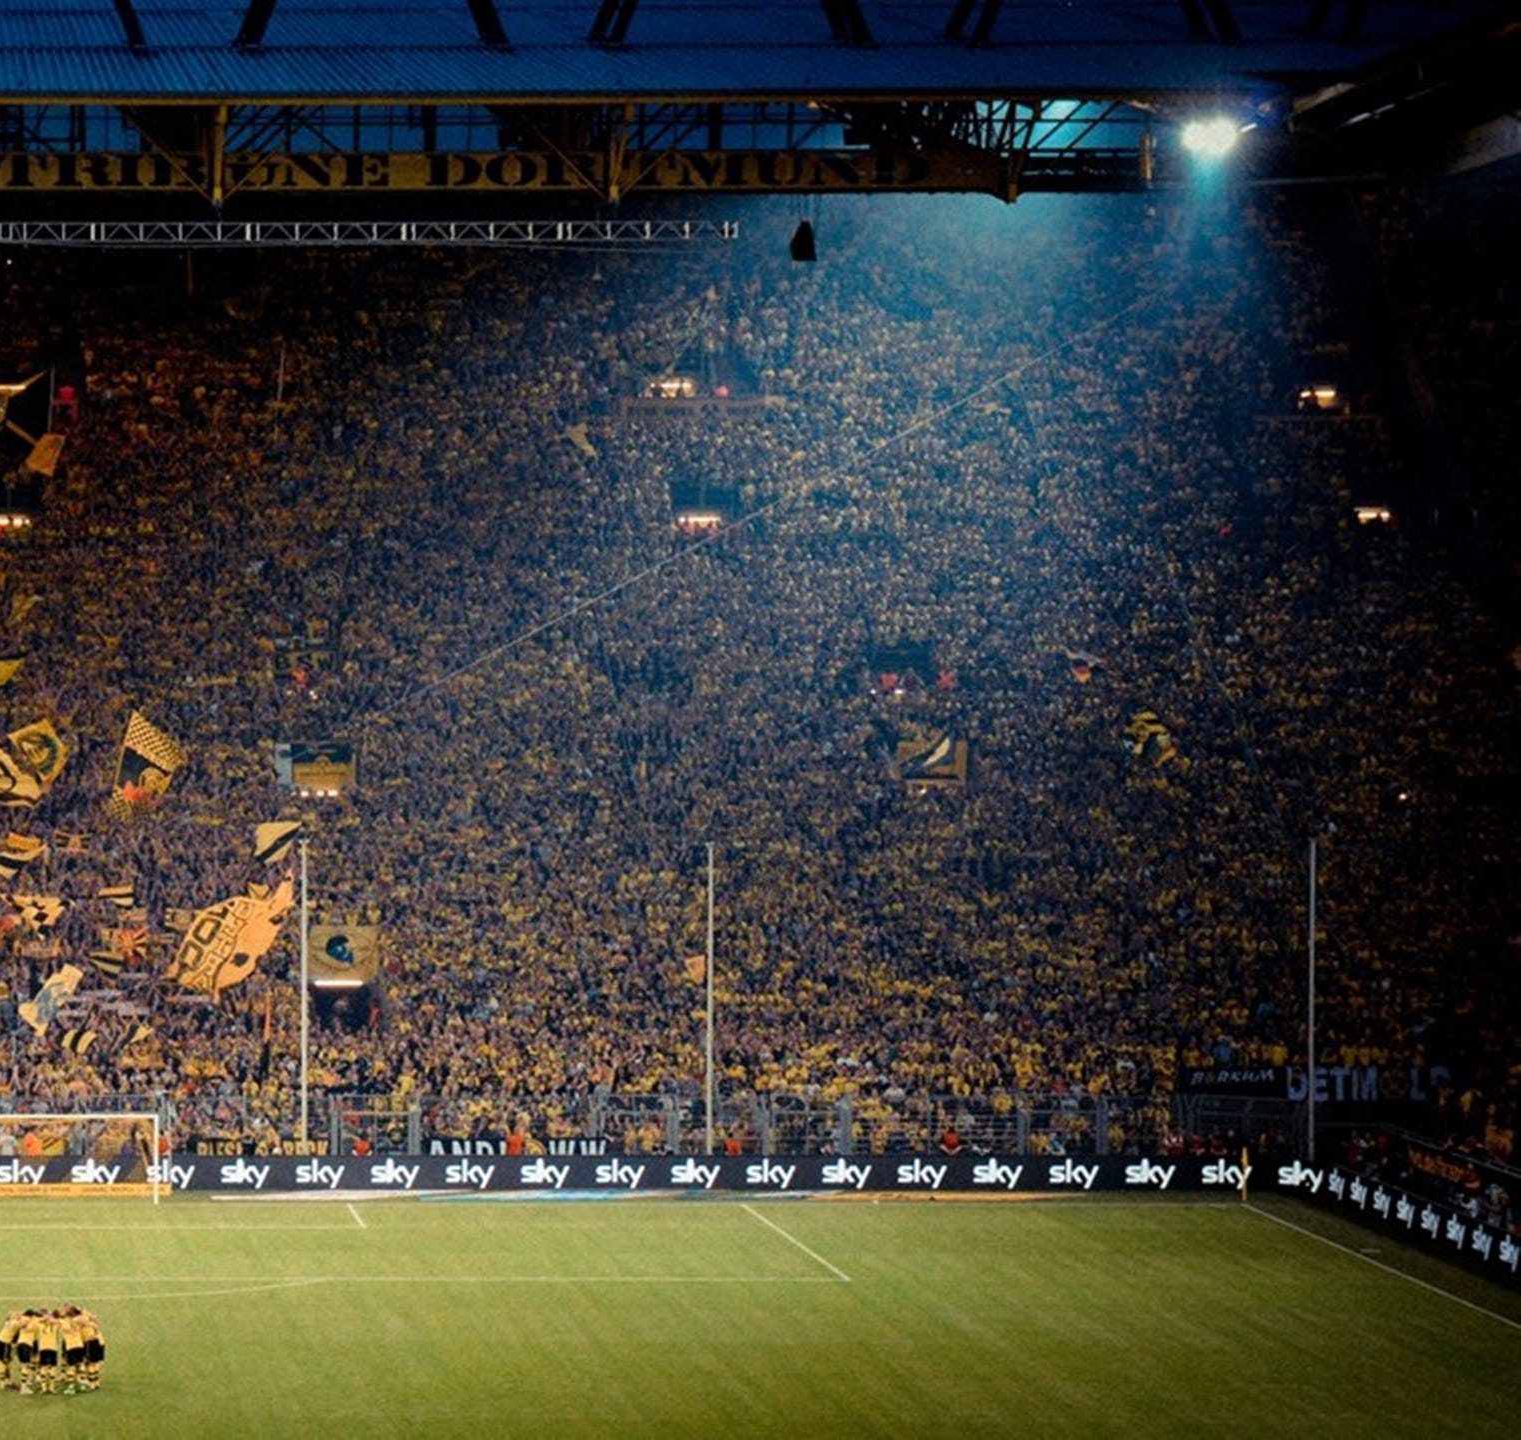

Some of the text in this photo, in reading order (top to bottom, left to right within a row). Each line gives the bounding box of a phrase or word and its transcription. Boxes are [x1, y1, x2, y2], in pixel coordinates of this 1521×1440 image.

[426, 153, 931, 187] DORTMUND
[71, 1159, 120, 1184] sky
[146, 1159, 195, 1190] sky
[221, 1159, 270, 1190] sky
[296, 1159, 345, 1190] sky
[371, 1159, 420, 1190] sky
[446, 1159, 495, 1190] sky
[521, 1159, 570, 1190] sky
[596, 1159, 645, 1190] sky
[671, 1159, 720, 1190] sky
[746, 1159, 796, 1190] sky
[822, 1159, 872, 1190] sky
[898, 1159, 947, 1190] sky
[973, 1159, 1023, 1190] sky
[1049, 1159, 1099, 1190] sky
[1125, 1159, 1176, 1190] sky
[1201, 1159, 1252, 1190] sky
[1278, 1161, 1324, 1193] sky
[1328, 1168, 1345, 1200] sky
[1350, 1176, 1367, 1209] sky
[1373, 1186, 1390, 1219] sky
[1396, 1194, 1414, 1228] sky
[1421, 1204, 1440, 1238] sky
[1446, 1214, 1466, 1249] sky
[1472, 1225, 1493, 1259] sky
